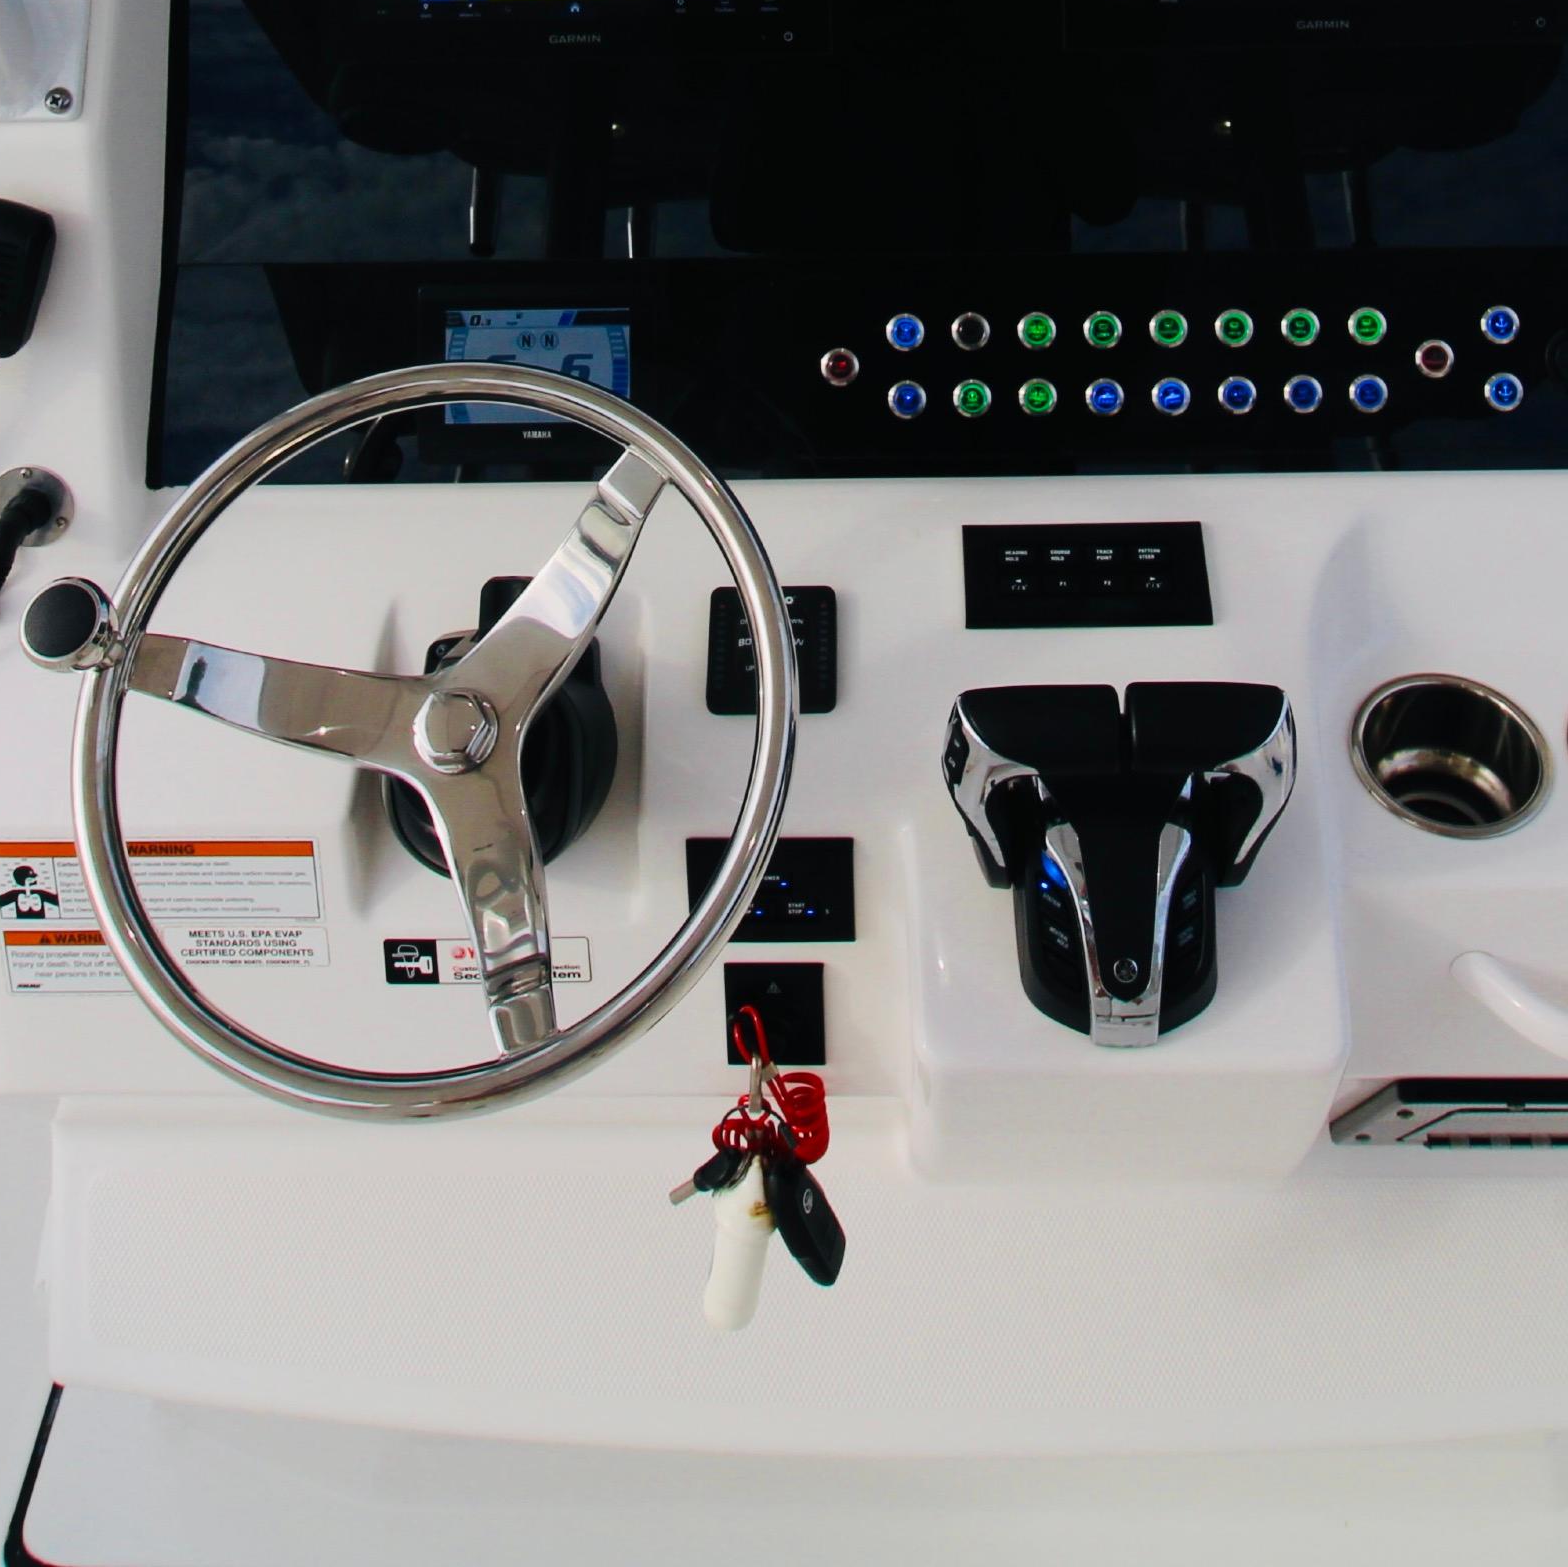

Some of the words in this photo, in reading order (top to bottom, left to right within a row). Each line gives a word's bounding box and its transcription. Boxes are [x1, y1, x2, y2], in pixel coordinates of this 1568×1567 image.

[1296, 19, 1350, 30] GARMIN
[548, 33, 602, 45] GARMIN
[522, 430, 552, 439] YAMAHA
[737, 637, 754, 648] BO
[127, 843, 195, 856] WARNING
[55, 933, 106, 945] WARNI
[188, 930, 225, 939] MEETS
[227, 930, 248, 939] U.S.
[251, 930, 271, 938] EPA
[275, 930, 303, 938] EVAP
[195, 939, 261, 948] STANDARDS
[264, 939, 298, 948] USING
[11, 950, 44, 960] Rotating
[46, 950, 80, 960] propeller
[82, 950, 99, 960] may
[180, 948, 236, 958] CERTIFIED
[238, 948, 314, 958] COMPONENTS
[12, 960, 34, 969] injury
[46, 960, 71, 968] death.
[73, 959, 93, 968] Shut
[55, 971, 88, 980] persons
[553, 970, 581, 979] tem
